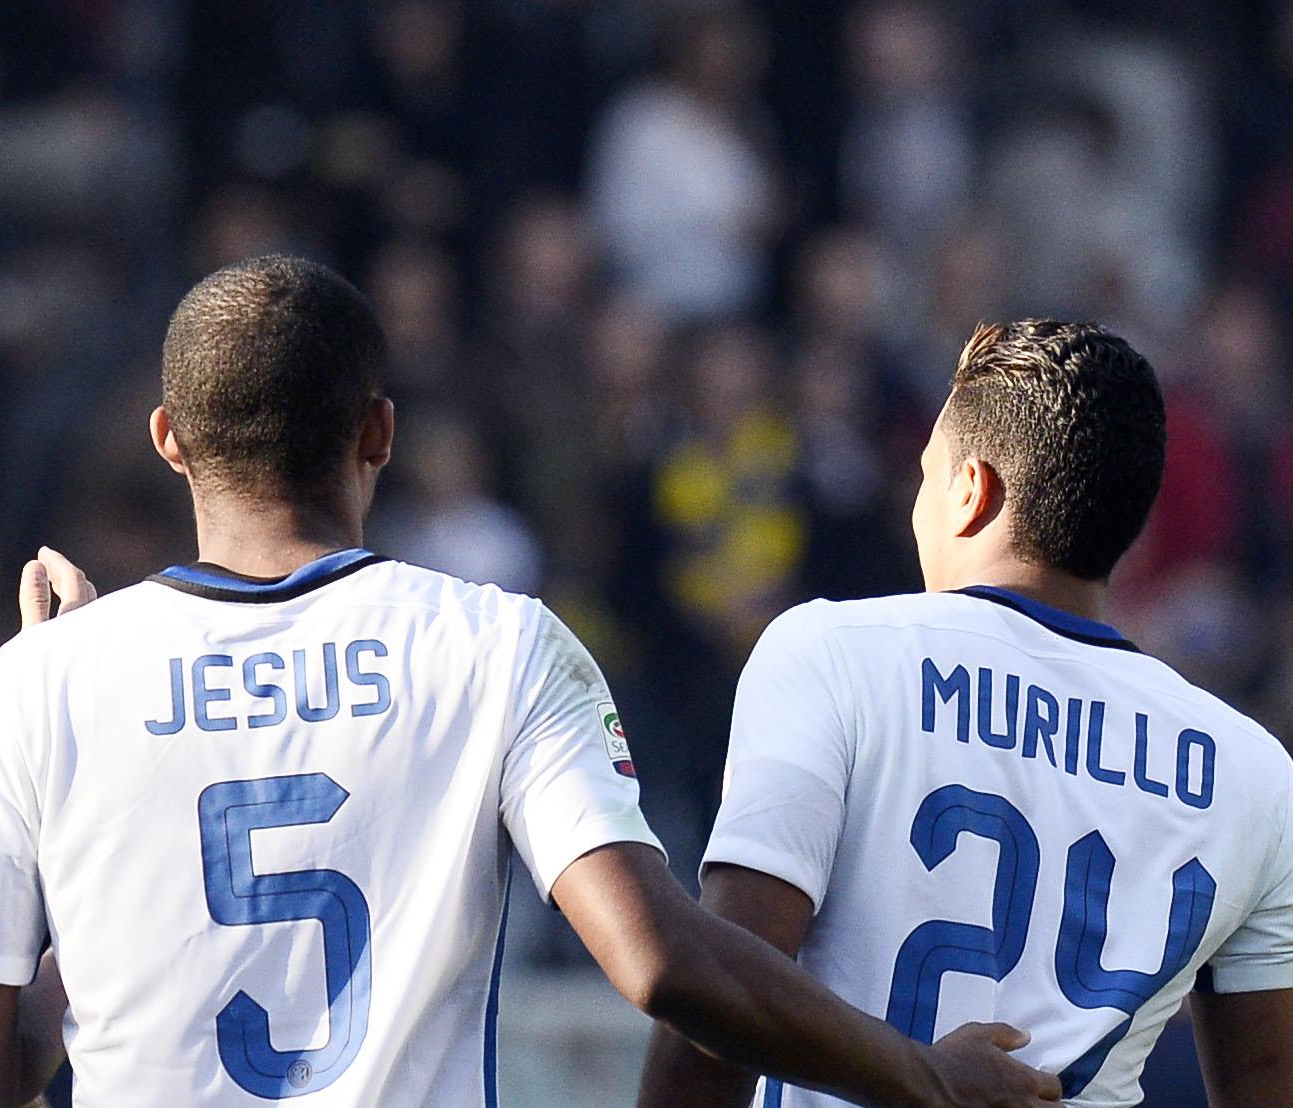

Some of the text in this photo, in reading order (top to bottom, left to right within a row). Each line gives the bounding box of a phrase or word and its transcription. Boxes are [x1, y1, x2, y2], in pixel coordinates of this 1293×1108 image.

[144, 638, 392, 737] JESUS
[920, 656, 1218, 813] MURILLO
[198, 772, 372, 1100] 5
[885, 782, 1218, 1100] 24
